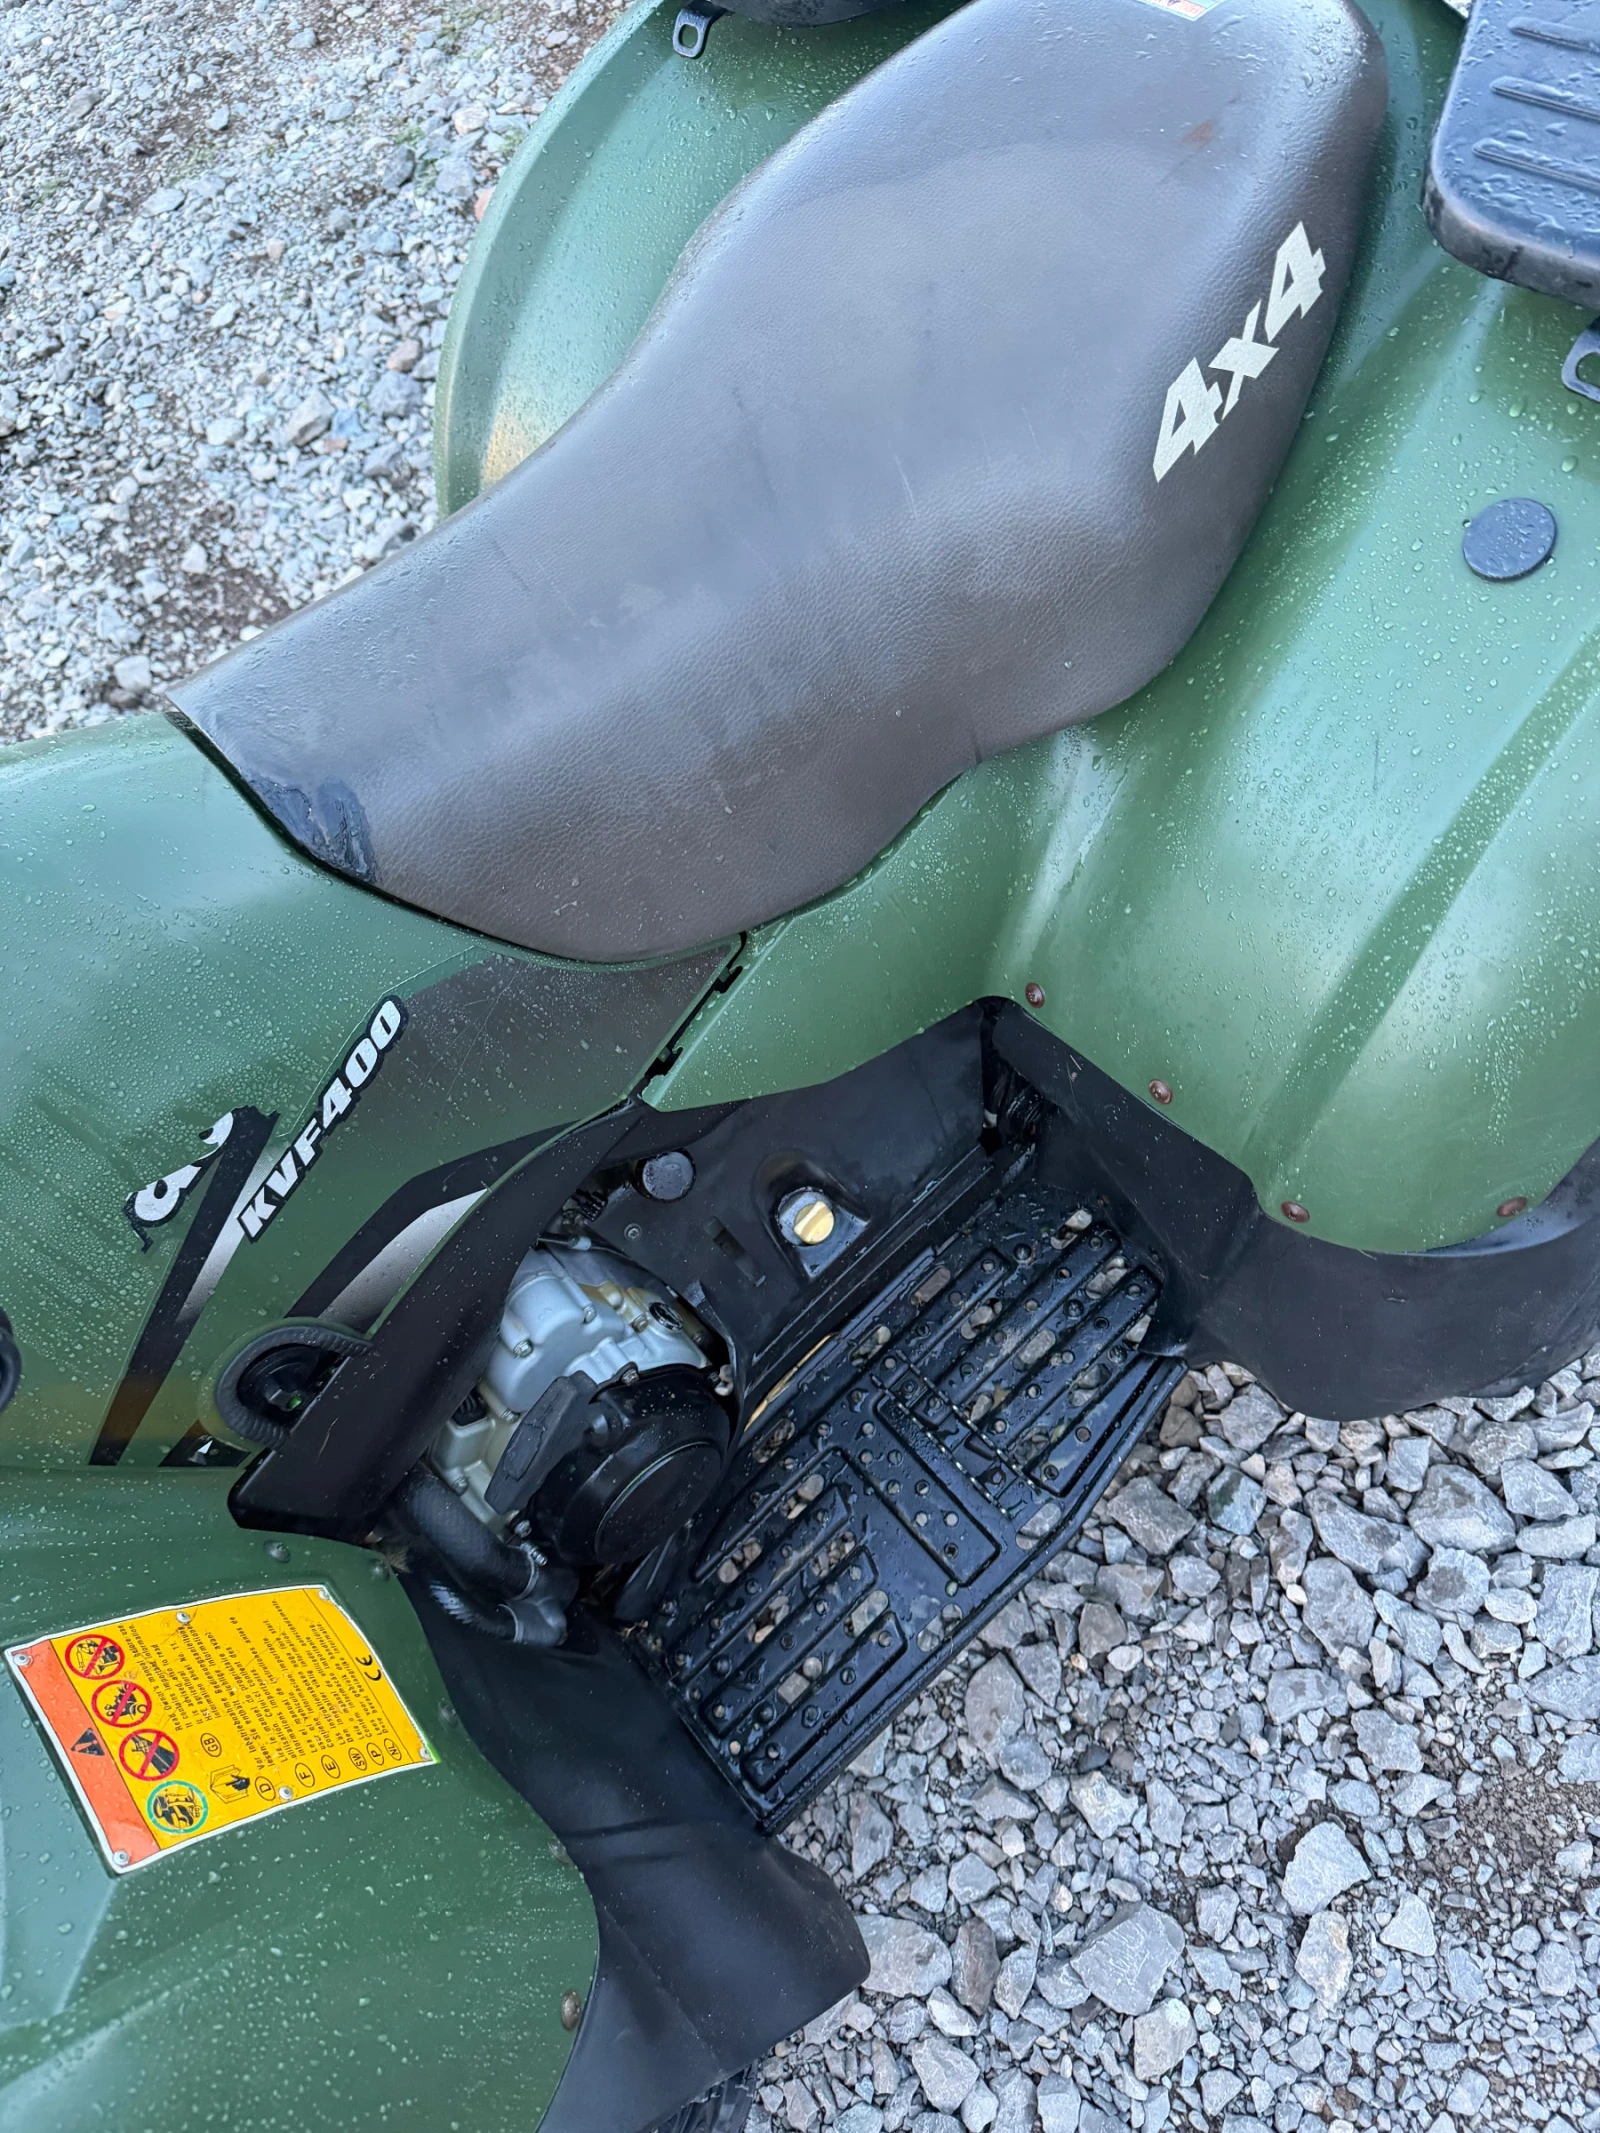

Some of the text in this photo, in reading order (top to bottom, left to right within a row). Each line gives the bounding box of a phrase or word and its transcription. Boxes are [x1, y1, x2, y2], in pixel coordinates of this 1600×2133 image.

[239, 998, 403, 1240] KVF400
[235, 1626, 251, 1644] antes
[150, 1643, 163, 1658] read
[175, 1651, 187, 1662] No.
[223, 1646, 237, 1658] des
[284, 1651, 300, 1668] noga
[135, 1659, 155, 1683] manual
[147, 1659, 171, 1691] important
[165, 1667, 178, 1681] also
[183, 1663, 199, 1681] sheet
[232, 1660, 256, 1688] contient
[355, 1654, 382, 1681] CE
[213, 1668, 235, 1697] wichtige
[305, 1669, 321, 1689] viktig
[340, 1673, 361, 1698] gebruik
[152, 1684, 172, 1711] Owner's
[173, 1682, 194, 1707] advised
[329, 1690, 349, 1714] manual
[168, 1692, 189, 1720] contains
[199, 1707, 213, 1721] HSE
[280, 1698, 301, 1725] manual
[358, 1700, 371, 1716] voor
[167, 1712, 183, 1731] Read
[219, 1696, 257, 1753] Inbetriebnahme
[249, 1705, 271, 1732] manuel
[369, 1718, 383, 1736] Lees
[247, 1727, 261, 1740] Sie
[275, 1710, 306, 1757] informations
[312, 1716, 335, 1748] Contiene
[341, 1728, 354, 1743] Den
[352, 1724, 365, 1740] Leia
[202, 1735, 221, 1752] GB
[305, 1738, 318, 1754] Lea
[386, 1741, 399, 1756] NL
[274, 1746, 289, 1763] Lire
[350, 1751, 366, 1767] SW
[369, 1748, 382, 1758] P
[252, 1755, 266, 1770] Vor
[323, 1761, 337, 1771] E
[297, 1770, 311, 1780] F
[258, 1782, 272, 1794] D
